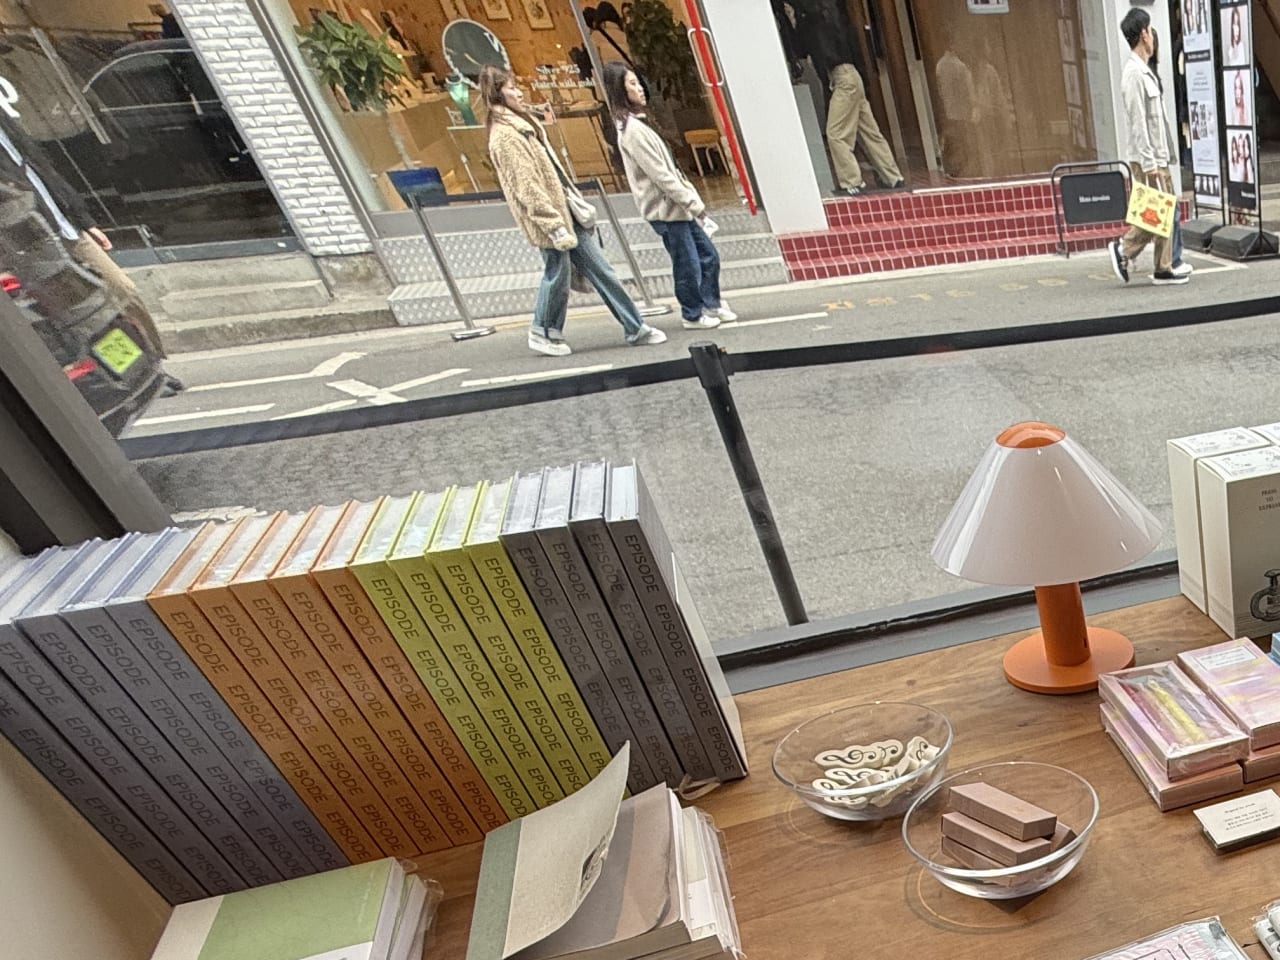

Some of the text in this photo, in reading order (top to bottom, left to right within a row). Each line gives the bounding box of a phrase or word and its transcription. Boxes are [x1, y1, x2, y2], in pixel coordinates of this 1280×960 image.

[0, 641, 65, 706] EPISODE
[65, 716, 129, 776] EPISODE
[127, 784, 185, 839] EPISODE
[86, 624, 152, 688] EPISODE
[150, 698, 208, 756] EPISODE
[206, 765, 260, 819] EPISODE
[129, 618, 338, 868] EPISODE EPISODE EPISODE EPISODE
[170, 611, 372, 860] EPISODE EPISODE EPISODE EPISODE
[212, 604, 405, 852] EPISODE EPISODE EPISODE EPISODE
[253, 597, 437, 844] EPISODE EPISODE EPISODE EPISODE
[292, 591, 470, 837] EPISODE EPISODE EPISODE EPISODE
[334, 583, 384, 646] EPISODE
[380, 655, 427, 712] EPISODE
[423, 720, 466, 773] EPISODE
[371, 578, 528, 818] EPISODE EPISODE EPISODE EPISOD
[410, 572, 457, 634] EPISODE
[453, 643, 496, 700] EPISODE
[492, 708, 532, 760] EPISODE
[447, 564, 492, 625] EPISODE
[487, 635, 529, 691] EPISODE
[524, 699, 563, 752] EPISODE
[484, 557, 593, 743] EPISODE EPISODE EPISODE
[518, 546, 559, 607] EPISODE
[554, 617, 592, 673] EPISODE
[587, 681, 621, 734] EPISODE
[552, 542, 591, 600] EPISODE
[586, 611, 623, 667] EPISODE
[616, 675, 651, 728] EPISODE
[587, 533, 705, 775] EPISODE EPISODE EPISODE EPISODE
[625, 534, 735, 773] EPISODE EPISODE EPISODE EPISODE
[18, 727, 192, 901] EPISODE EPISODE EPISOD
[39, 631, 272, 885] EPISODE EPISODE EPISODE EPISODE
